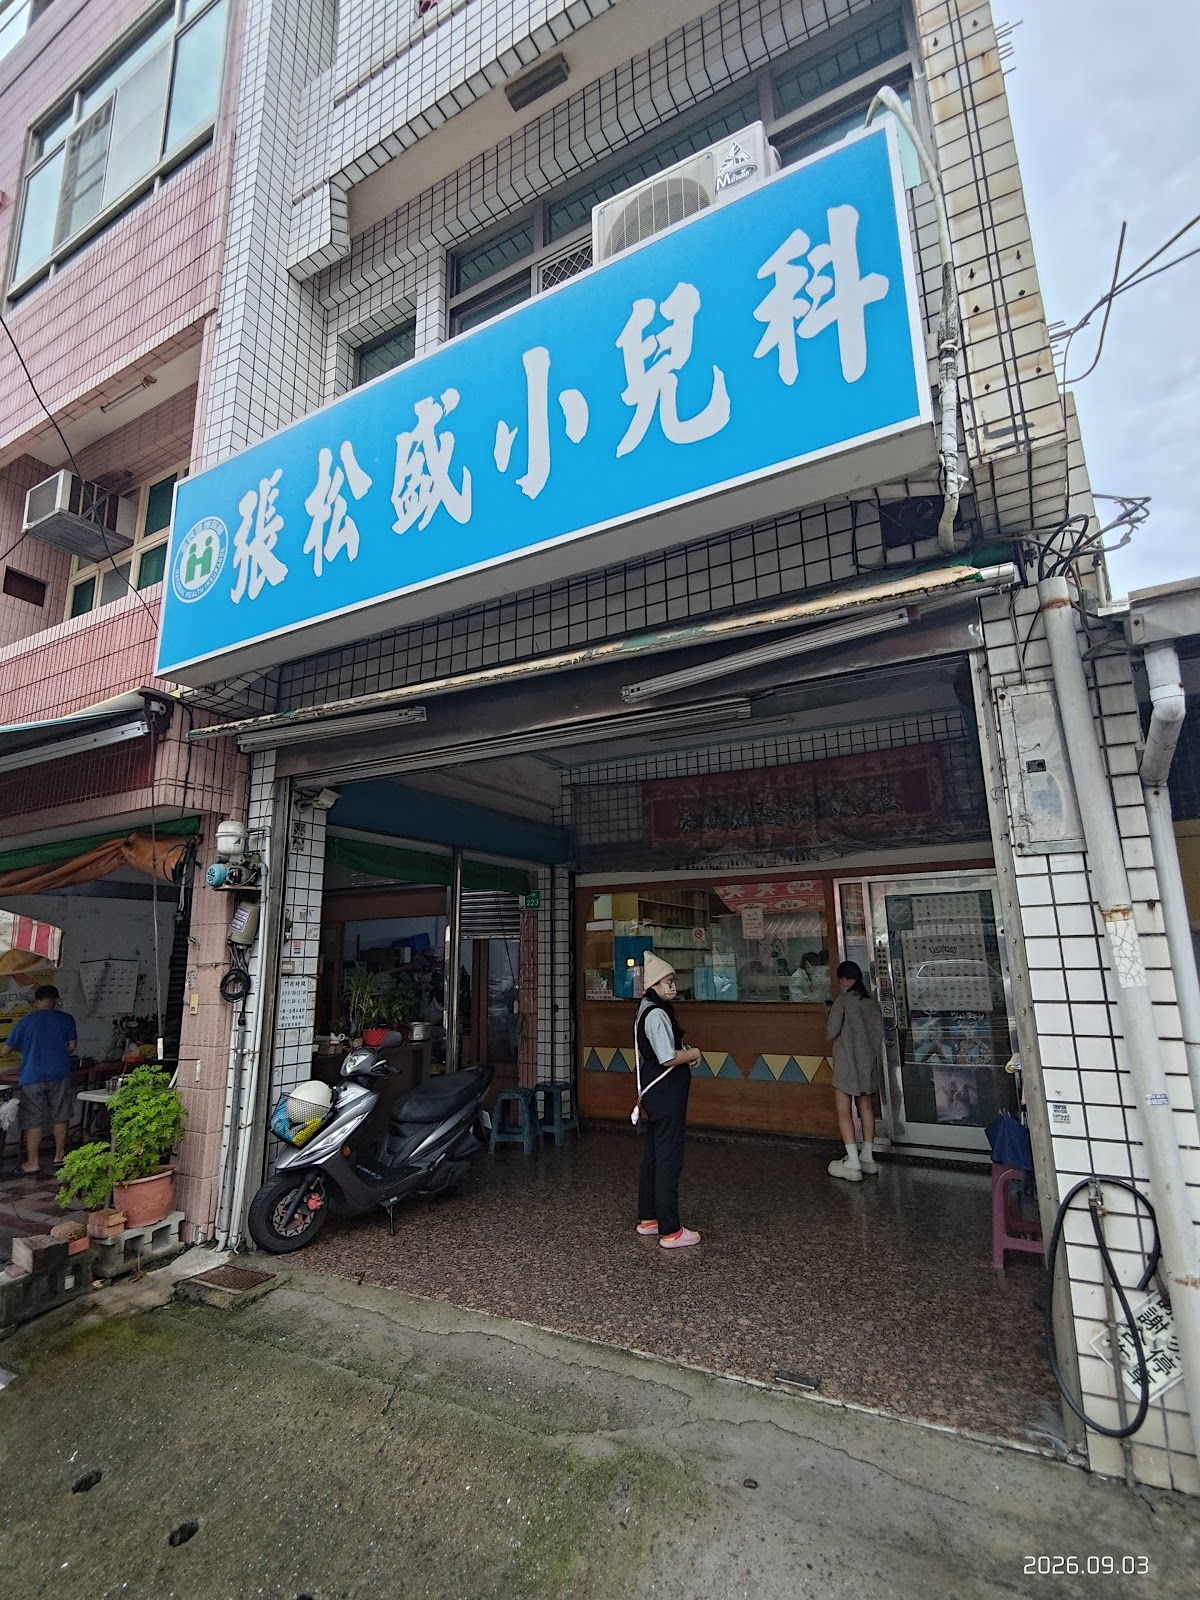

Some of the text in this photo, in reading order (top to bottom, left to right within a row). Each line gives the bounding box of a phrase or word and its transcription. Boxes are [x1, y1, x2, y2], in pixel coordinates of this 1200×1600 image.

[230, 204, 889, 604] 張松盛小兒科
[185, 587, 204, 598] HEALTH
[204, 547, 226, 590] INSURANCE
[526, 898, 539, 907] 223
